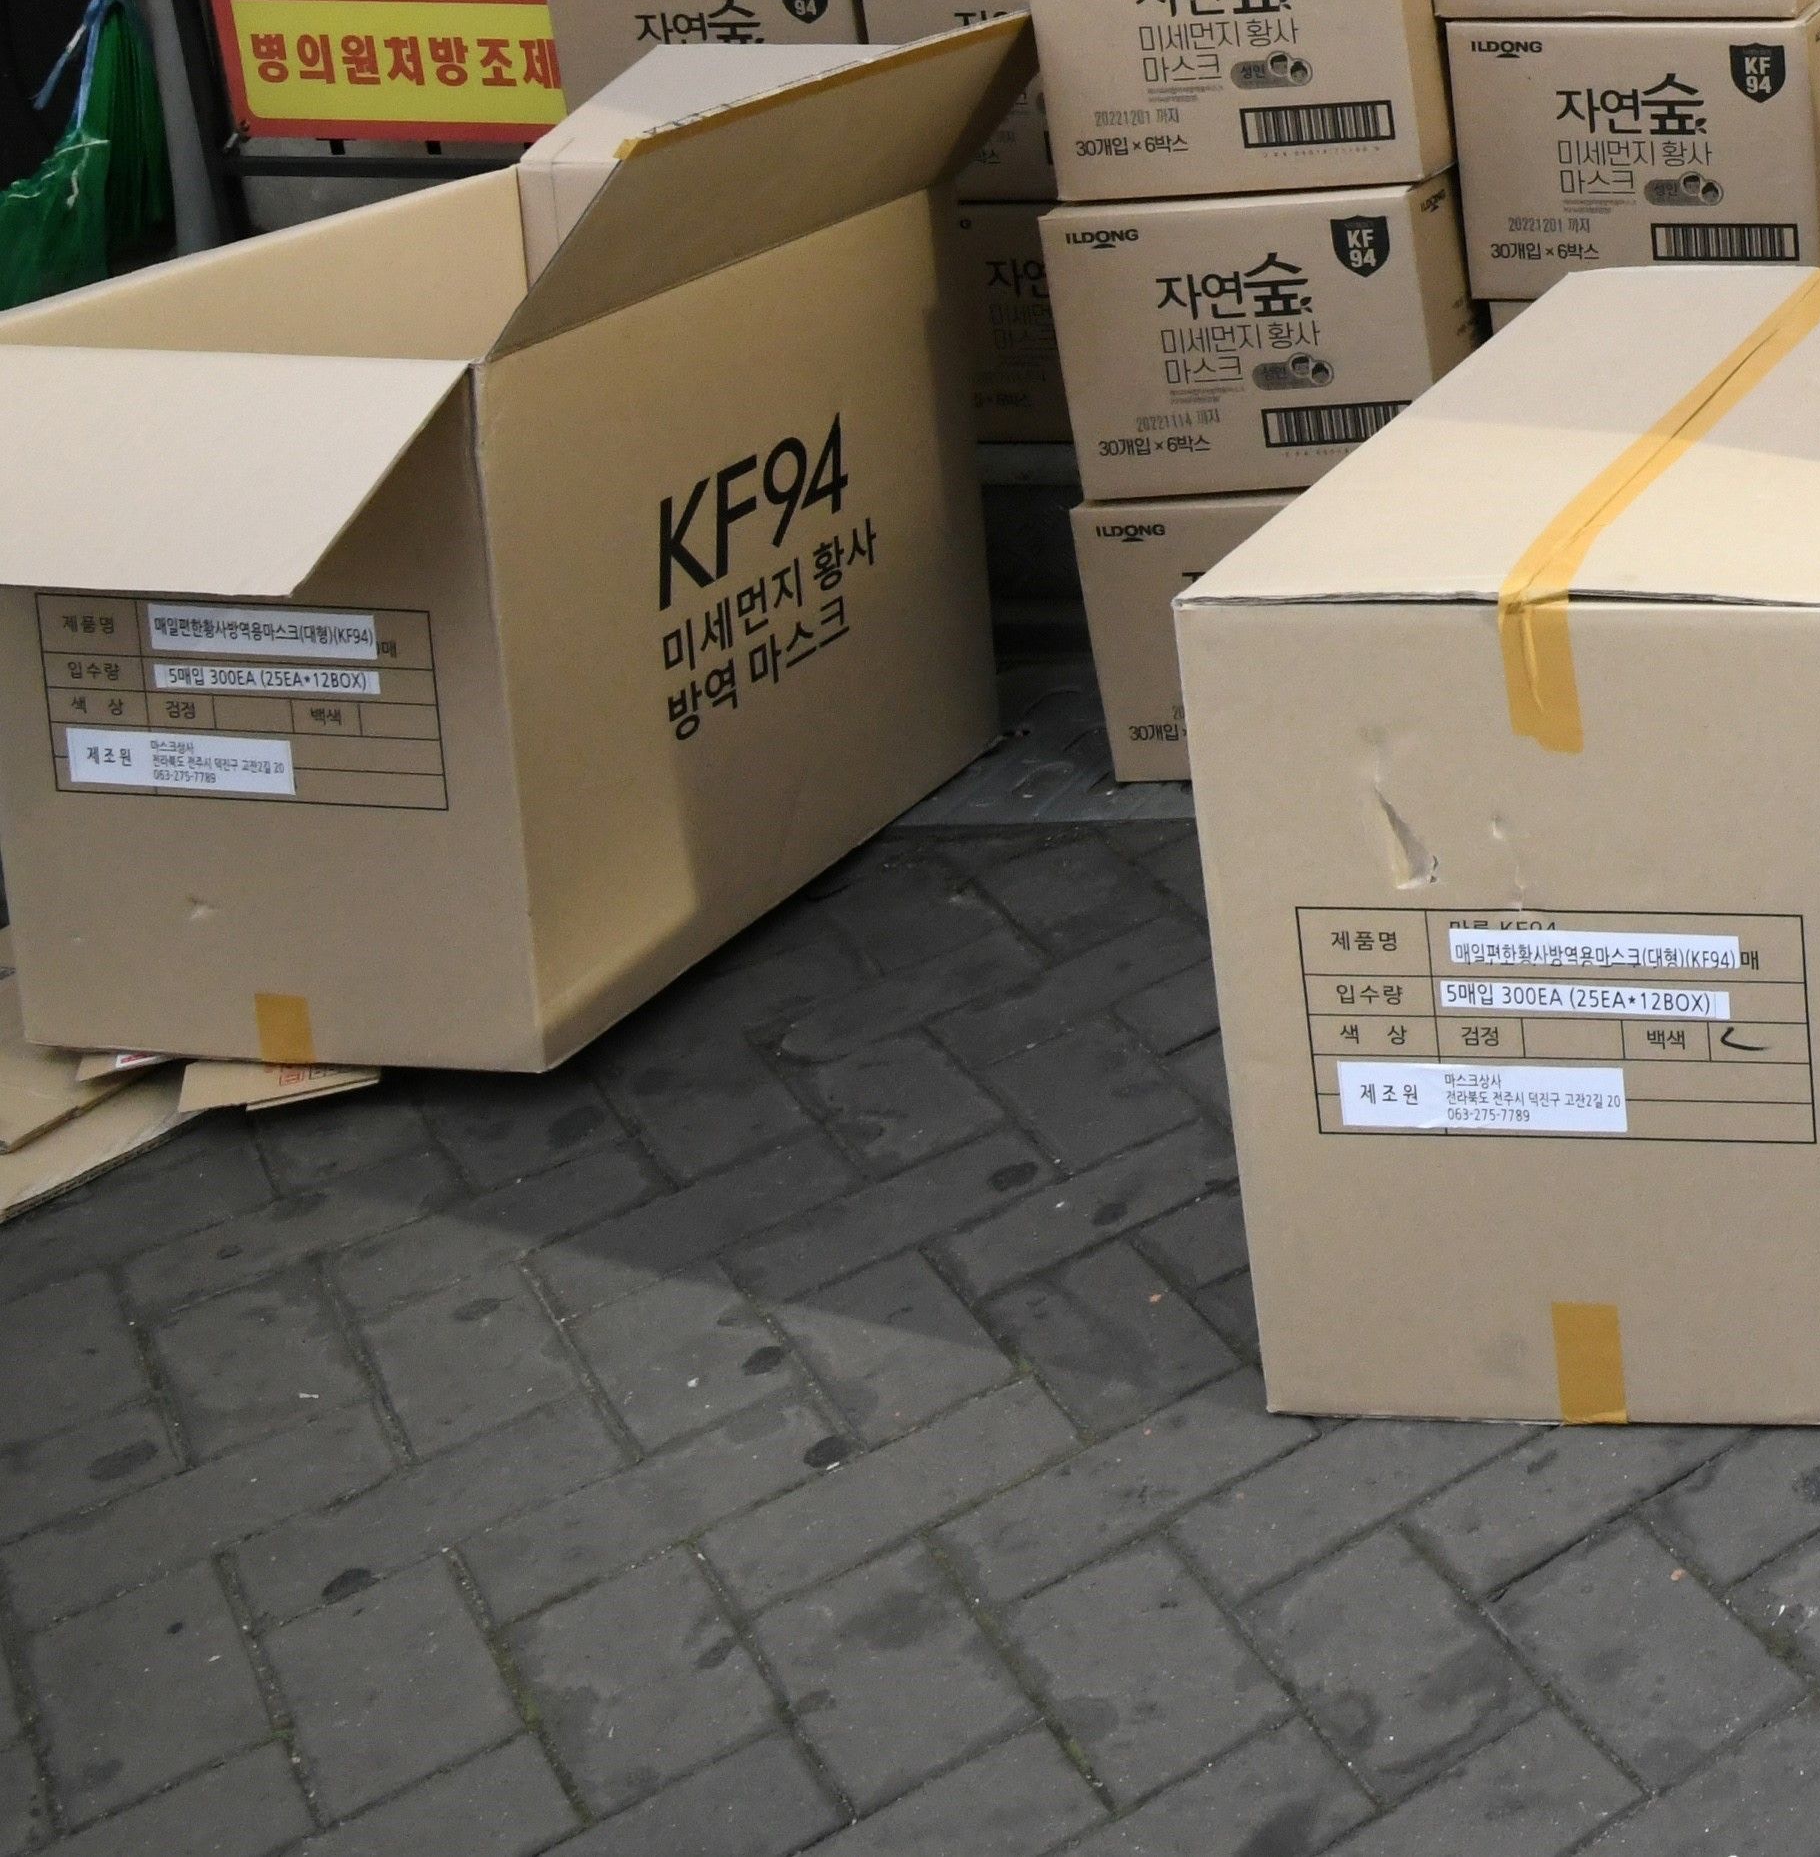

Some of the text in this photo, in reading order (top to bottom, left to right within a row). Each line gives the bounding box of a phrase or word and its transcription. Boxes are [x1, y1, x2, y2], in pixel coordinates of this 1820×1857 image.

[250, 33, 562, 90] 병의원처방조제
[659, 412, 849, 611] KF94
[662, 517, 877, 671] 미세먼지 황사
[153, 616, 374, 646] 매일편한황사방역용마스크(대형)(KF94)
[168, 667, 206, 686] 5매입
[210, 669, 257, 688] 300EA
[667, 594, 851, 742] 방역 마스크
[1335, 982, 1404, 1007] 입수량
[1446, 982, 1496, 1007] 5매입
[1500, 985, 1564, 1009] 300EA
[1444, 1072, 1502, 1090] 마스크상사
